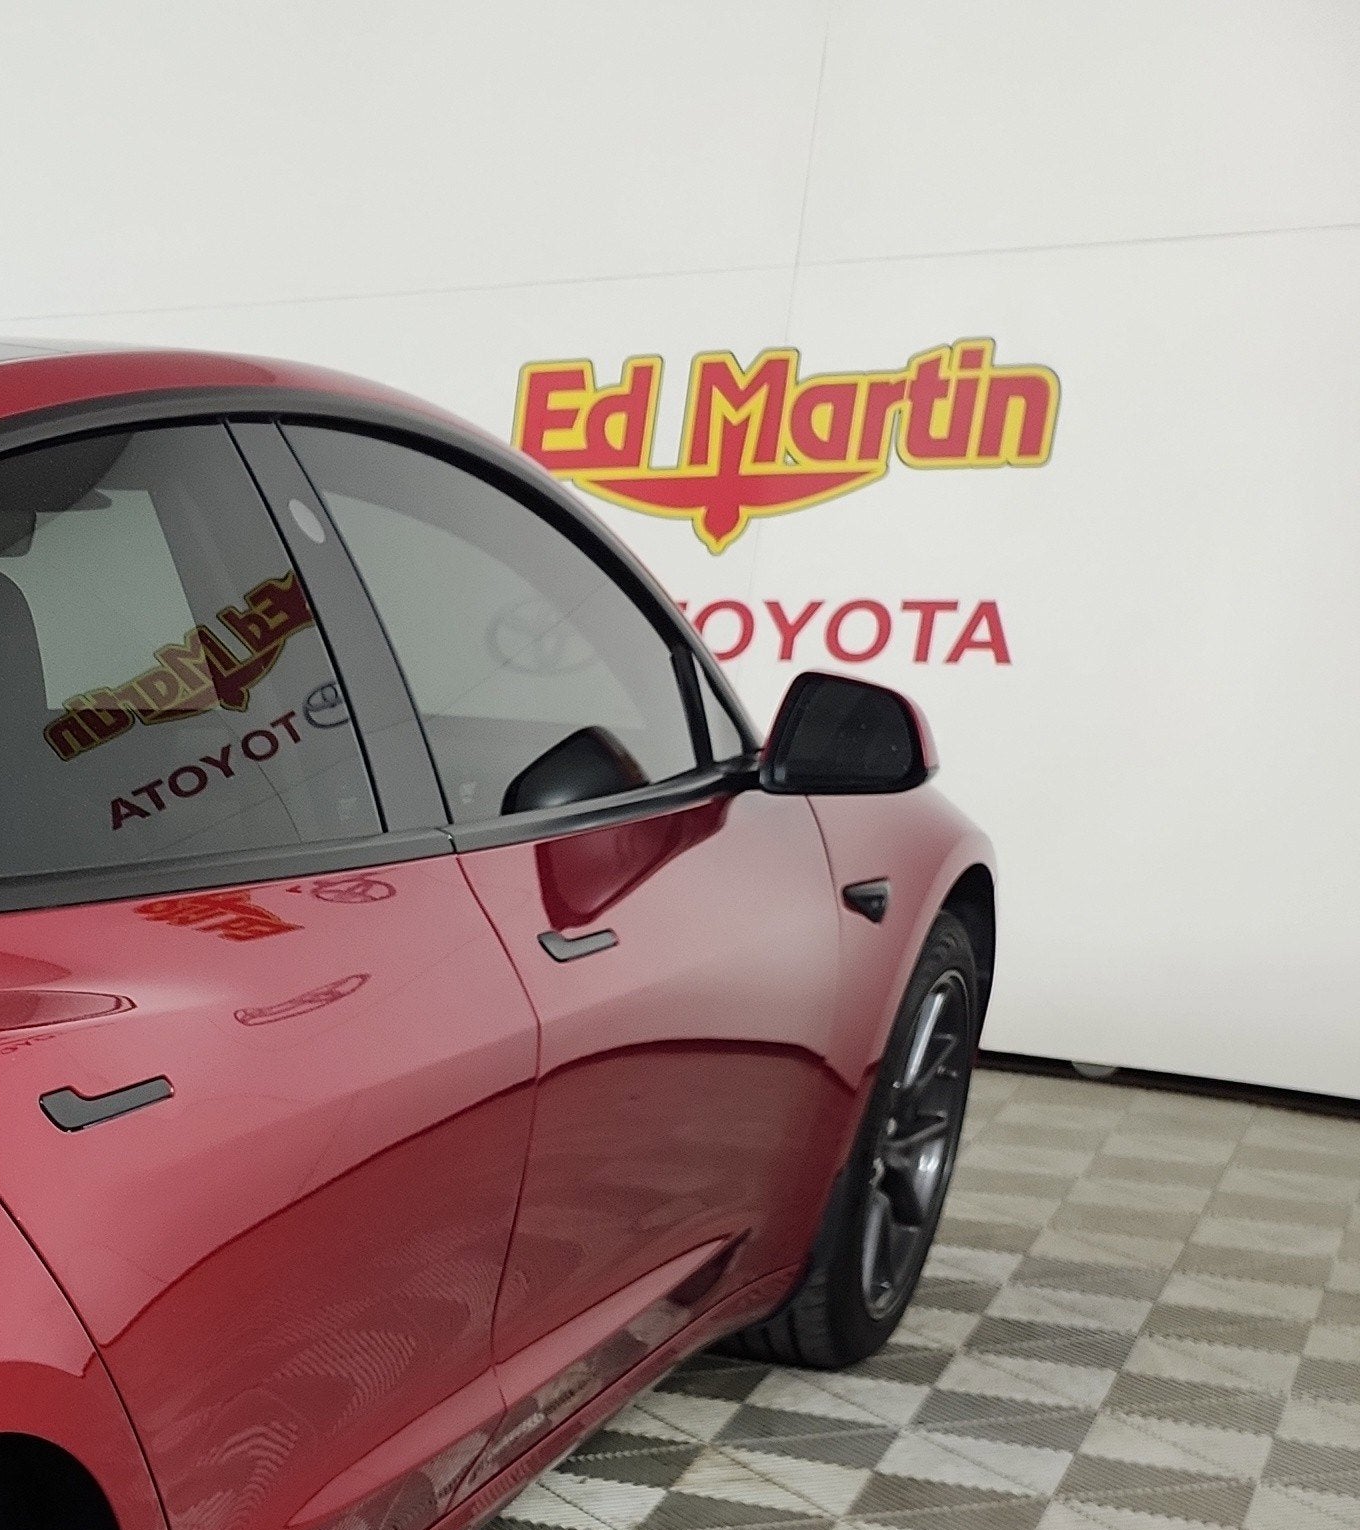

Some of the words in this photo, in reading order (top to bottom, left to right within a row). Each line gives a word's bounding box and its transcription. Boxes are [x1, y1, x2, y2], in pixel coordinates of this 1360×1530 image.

[515, 356, 662, 476] Ed
[682, 339, 1060, 468] Martin
[678, 599, 1011, 666] OYOTA
